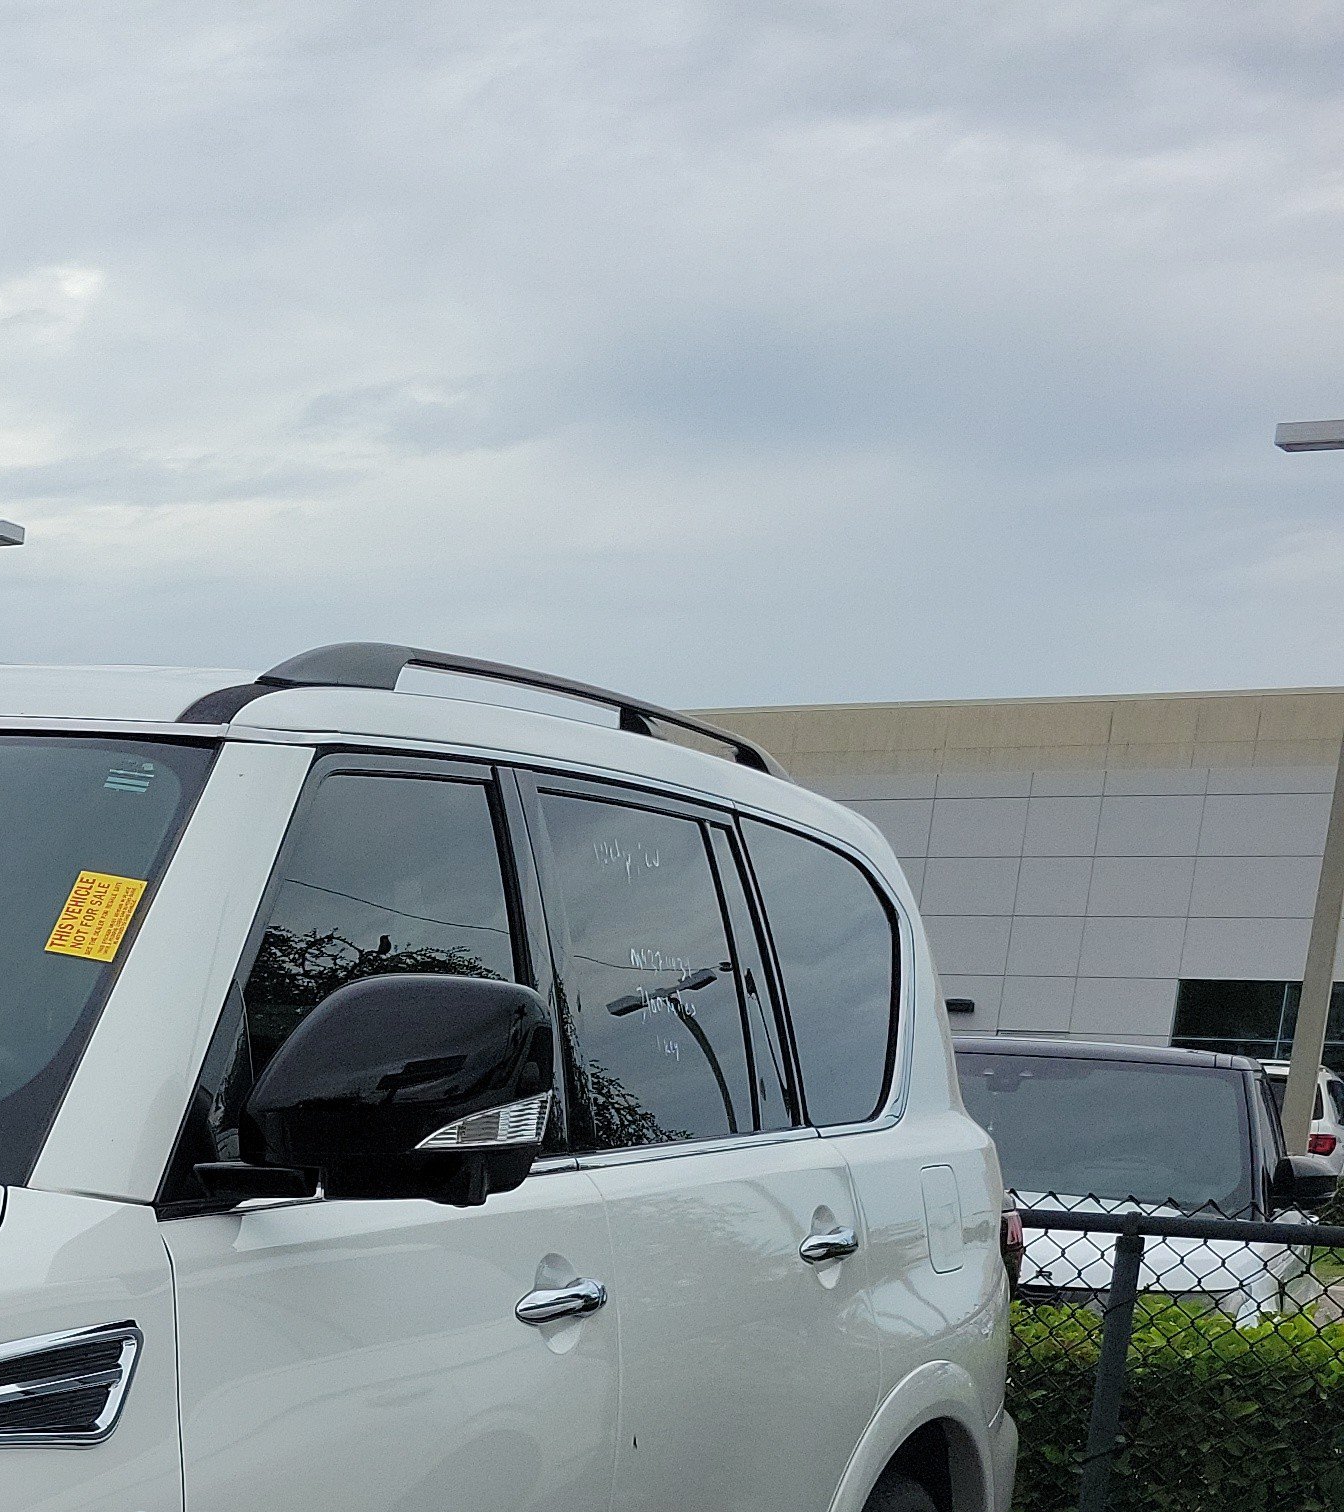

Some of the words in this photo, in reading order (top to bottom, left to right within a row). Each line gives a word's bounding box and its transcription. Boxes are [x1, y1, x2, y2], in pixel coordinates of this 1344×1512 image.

[50, 923, 74, 948] THIS
[62, 877, 96, 922] VEHICLE
[70, 928, 88, 949] NOT
[80, 908, 97, 928] FOR
[90, 882, 112, 906] SALE
